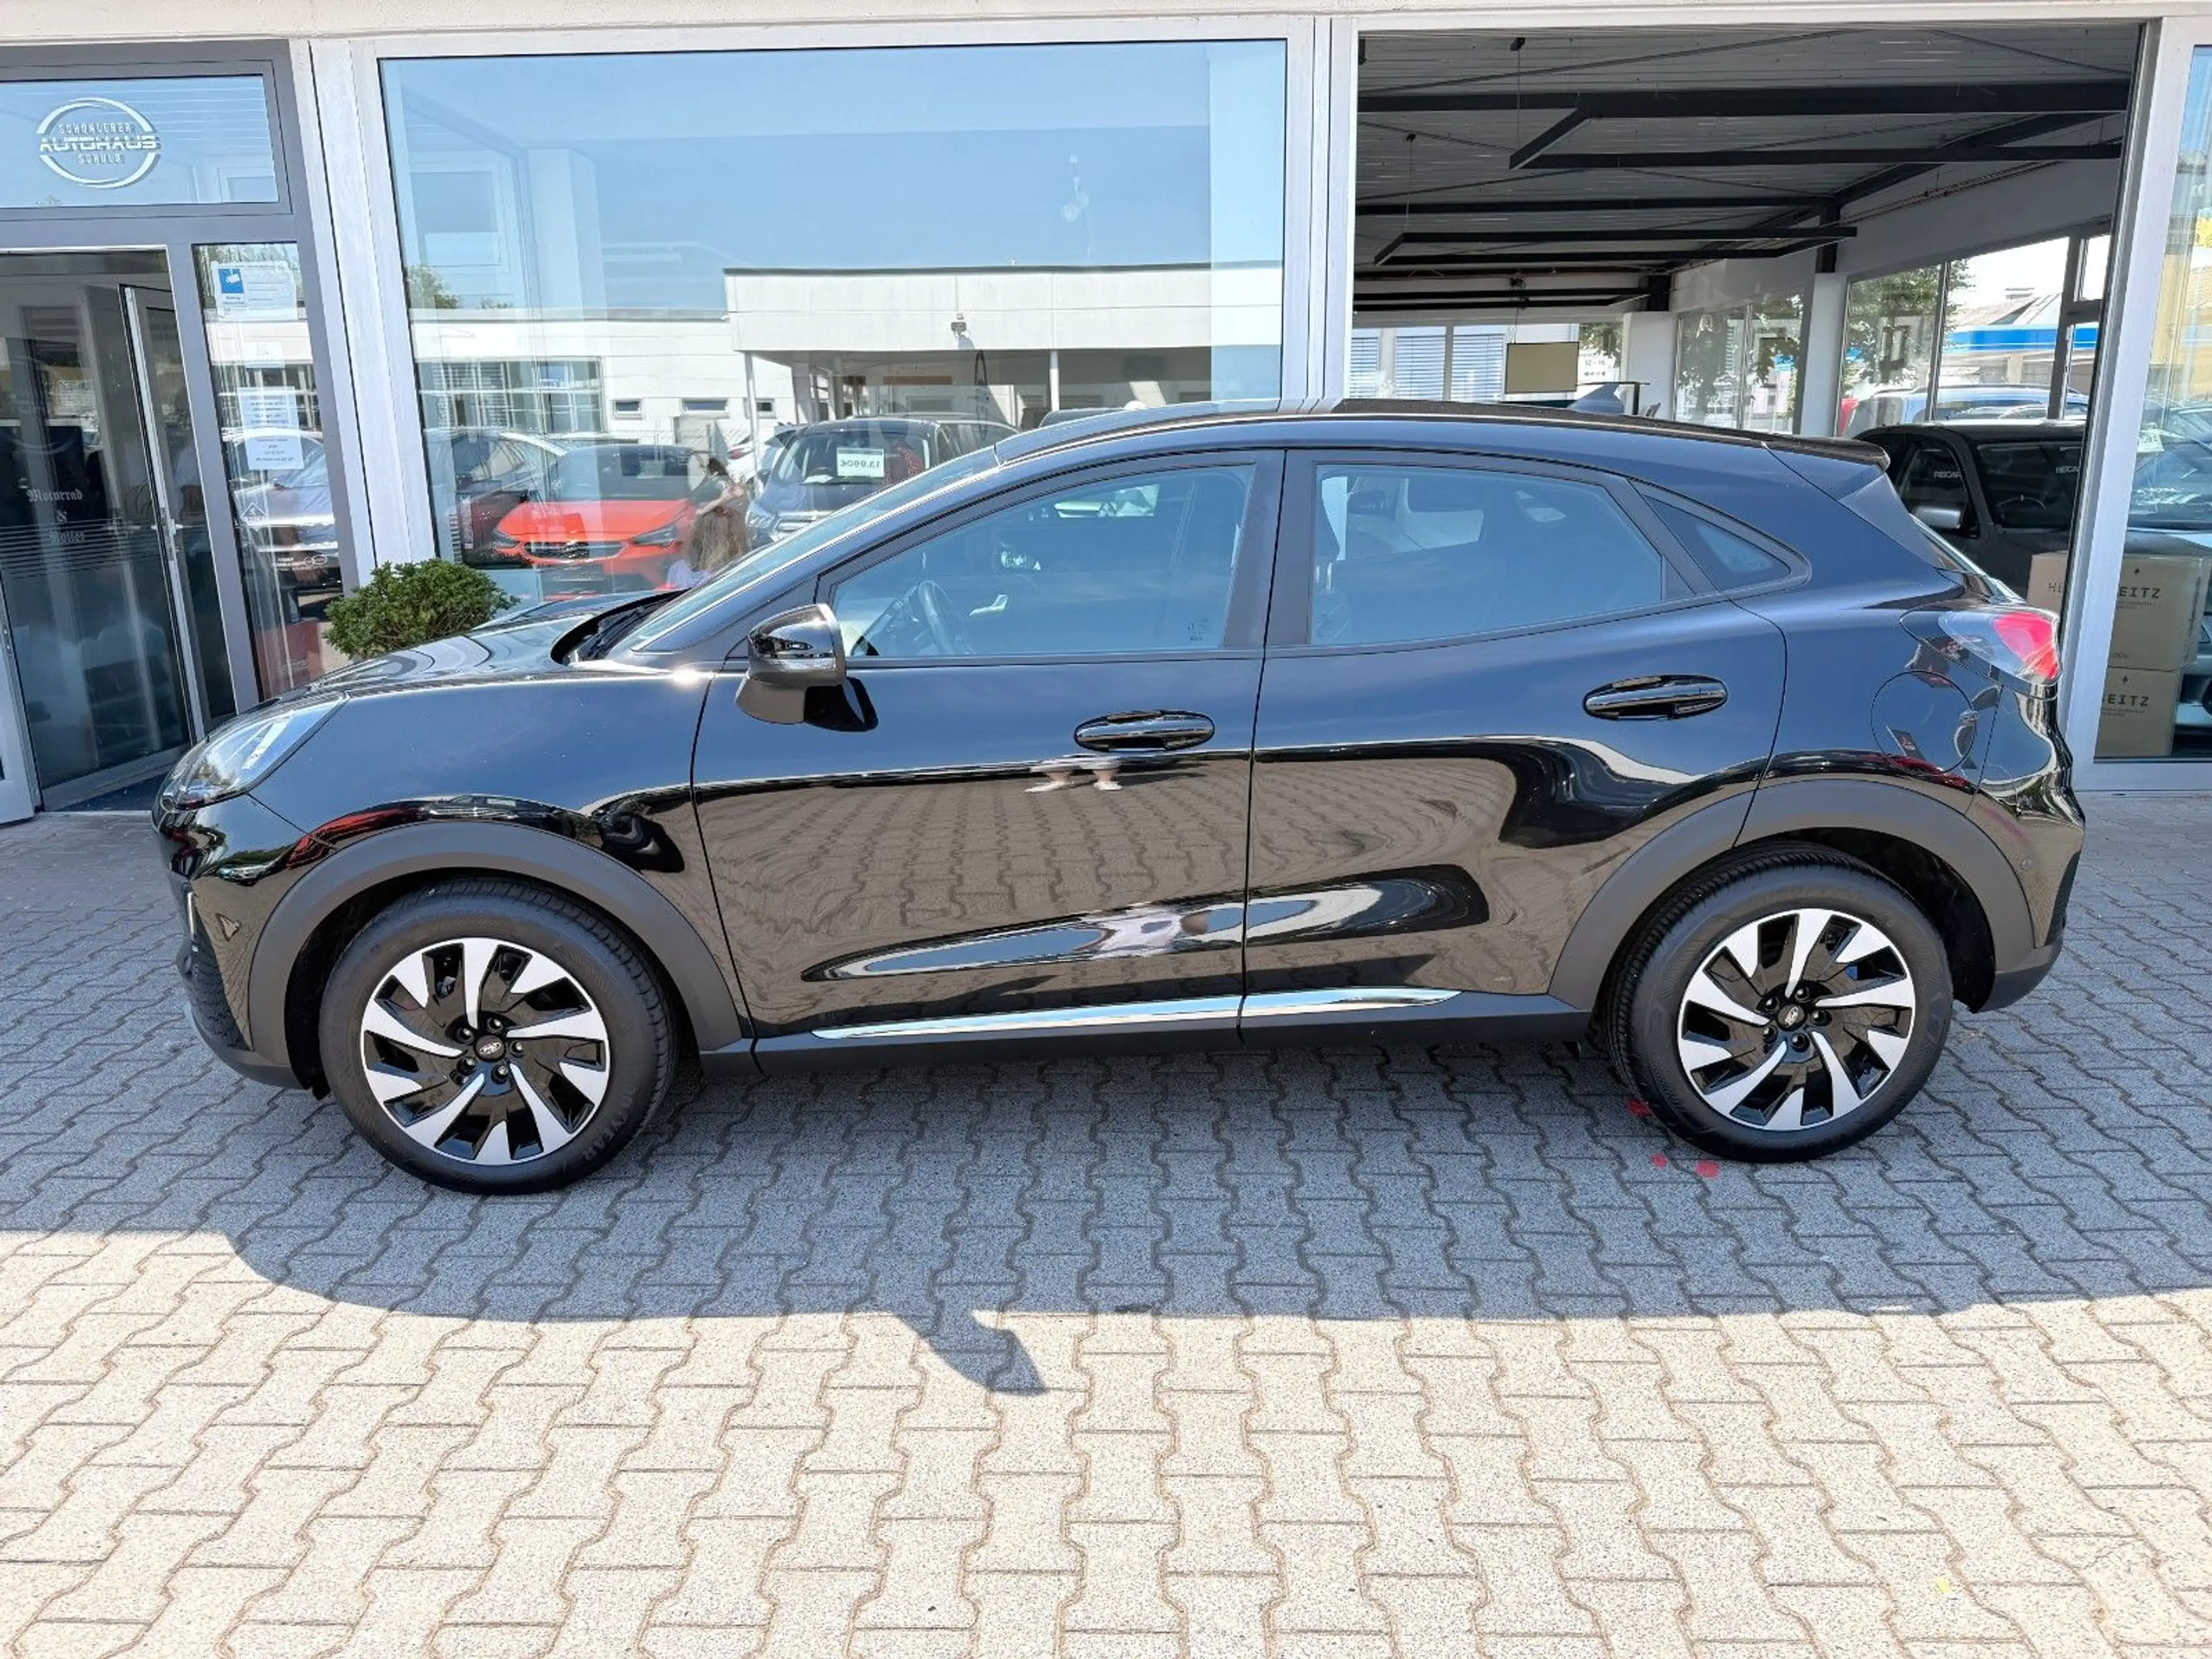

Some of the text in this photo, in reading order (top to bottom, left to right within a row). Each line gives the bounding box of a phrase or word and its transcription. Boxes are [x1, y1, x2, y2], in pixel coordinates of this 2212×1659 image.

[40, 135, 158, 151] AUTOHAUS
[1934, 470, 1961, 478] RECAR
[2056, 465, 2078, 474] RECA
[26, 488, 83, 503] Motorrad
[2119, 586, 2160, 598] EITZ
[2103, 694, 2149, 706] EITZ
